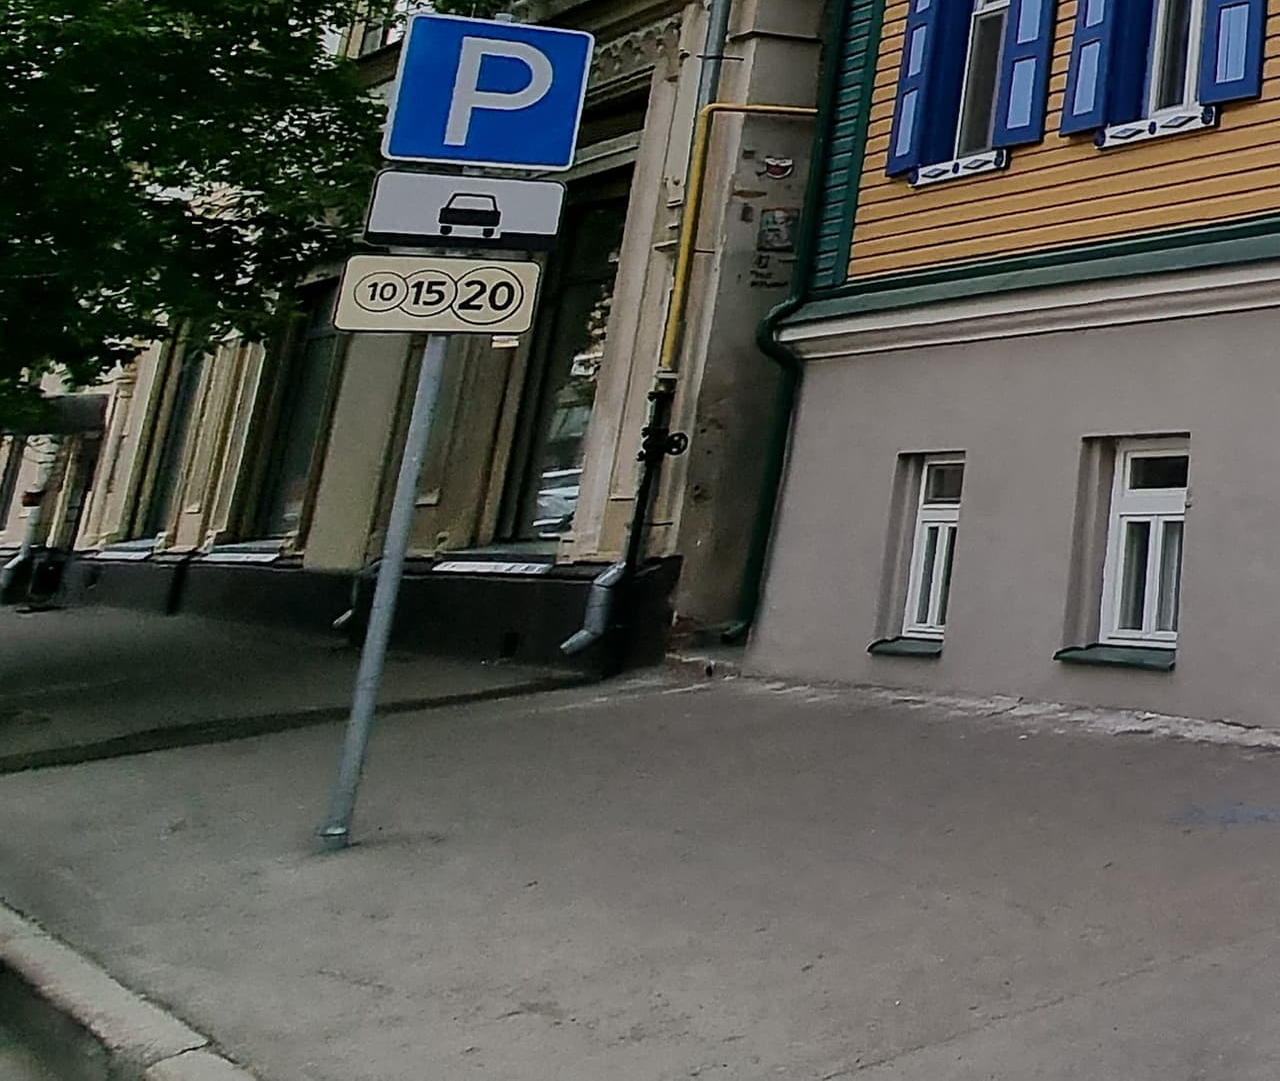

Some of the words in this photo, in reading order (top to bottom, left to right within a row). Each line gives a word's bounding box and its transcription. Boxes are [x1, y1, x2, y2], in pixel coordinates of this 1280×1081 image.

[443, 35, 553, 147] P
[367, 281, 398, 302] 10
[410, 279, 447, 306] 15
[457, 279, 515, 311] 20
